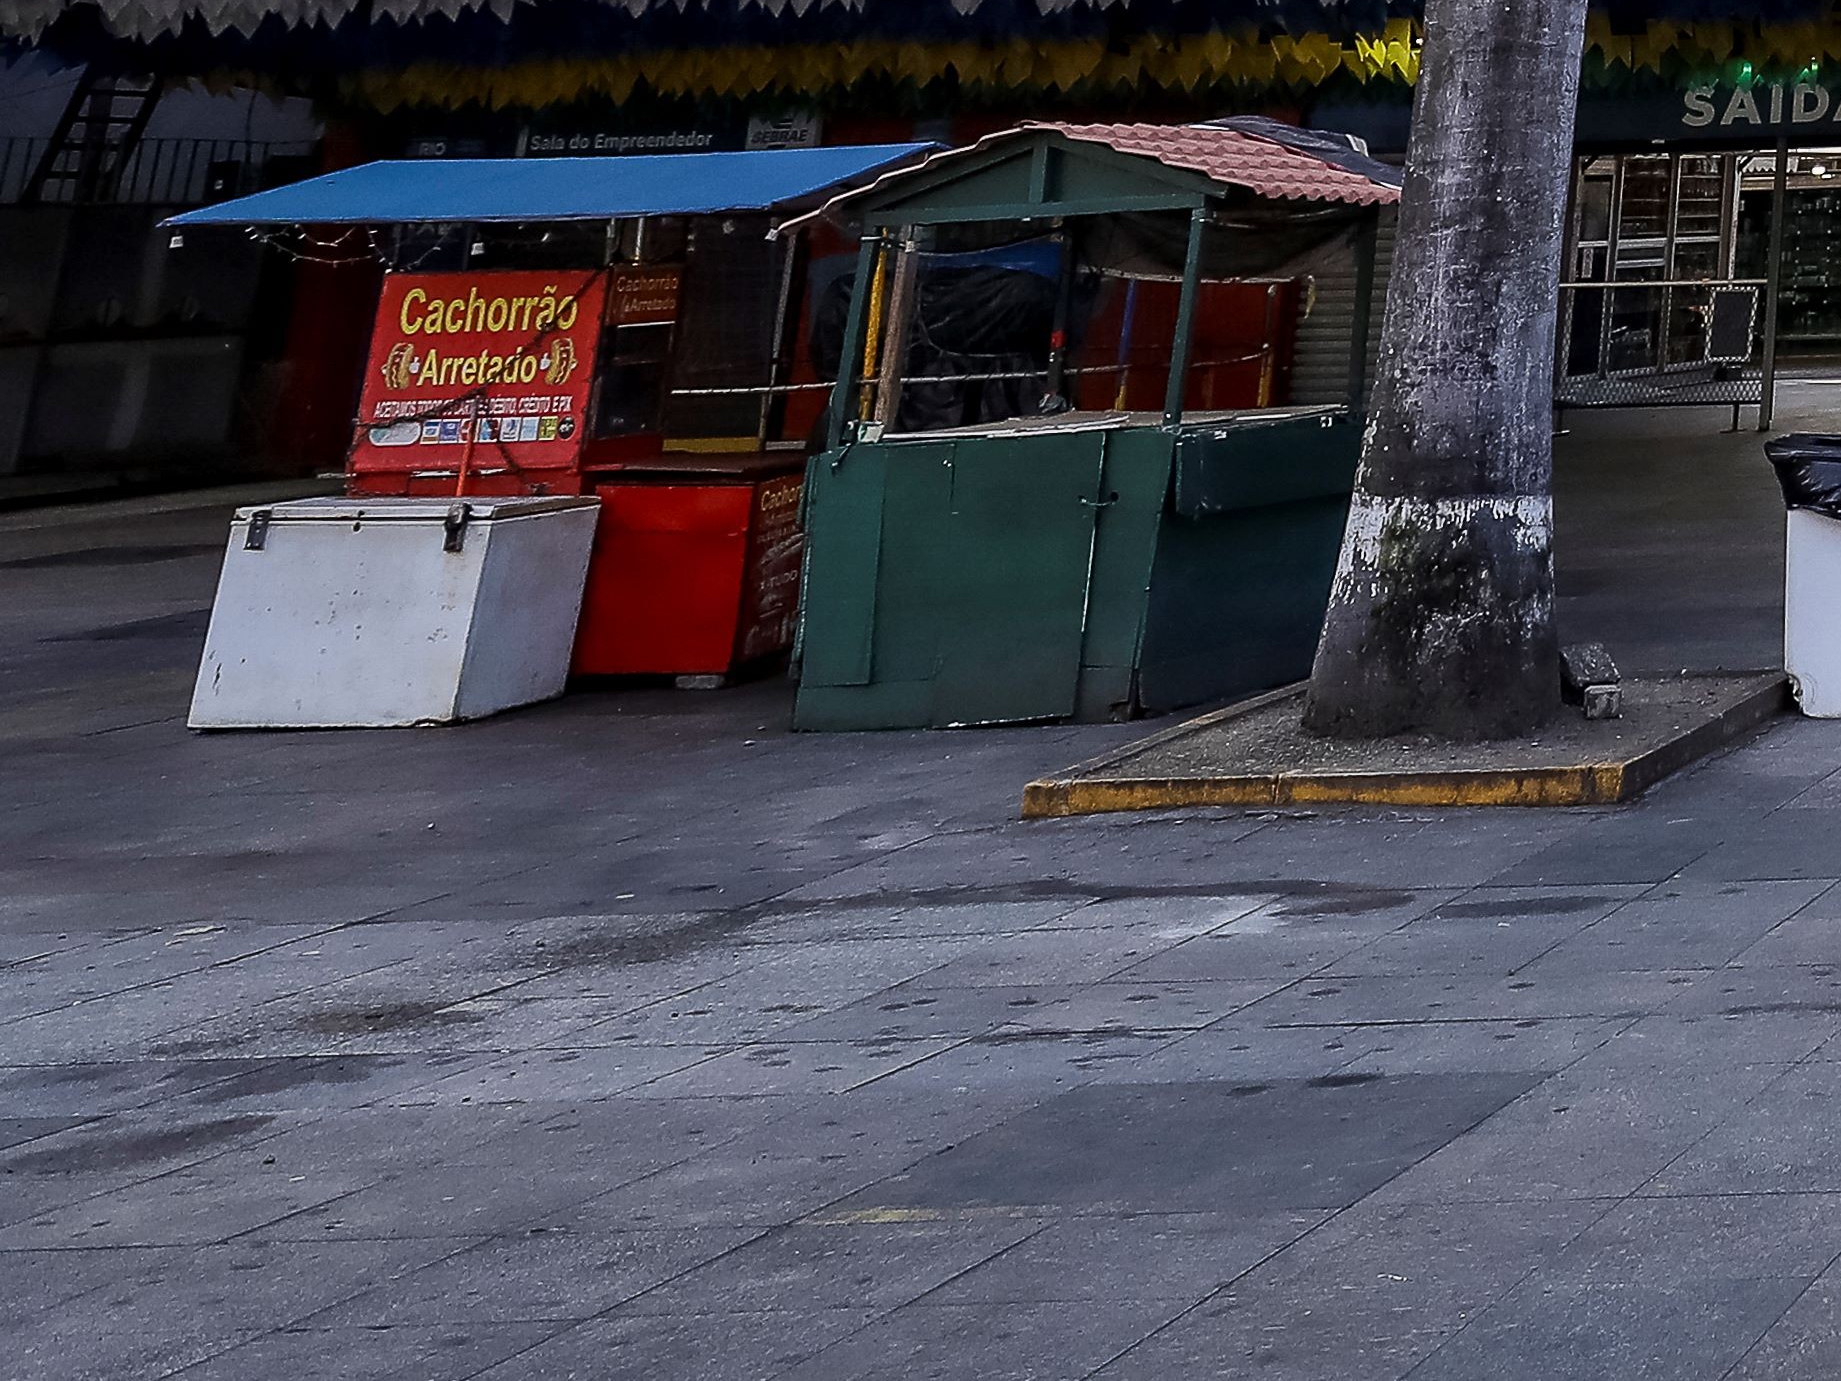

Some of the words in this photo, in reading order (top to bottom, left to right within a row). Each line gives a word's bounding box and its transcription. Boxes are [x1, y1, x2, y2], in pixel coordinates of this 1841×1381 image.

[530, 133, 567, 151] Sala
[568, 132, 590, 150] do
[593, 129, 714, 152] Empreendedor
[399, 285, 578, 335] Cachorrão
[415, 347, 538, 386] Arretado
